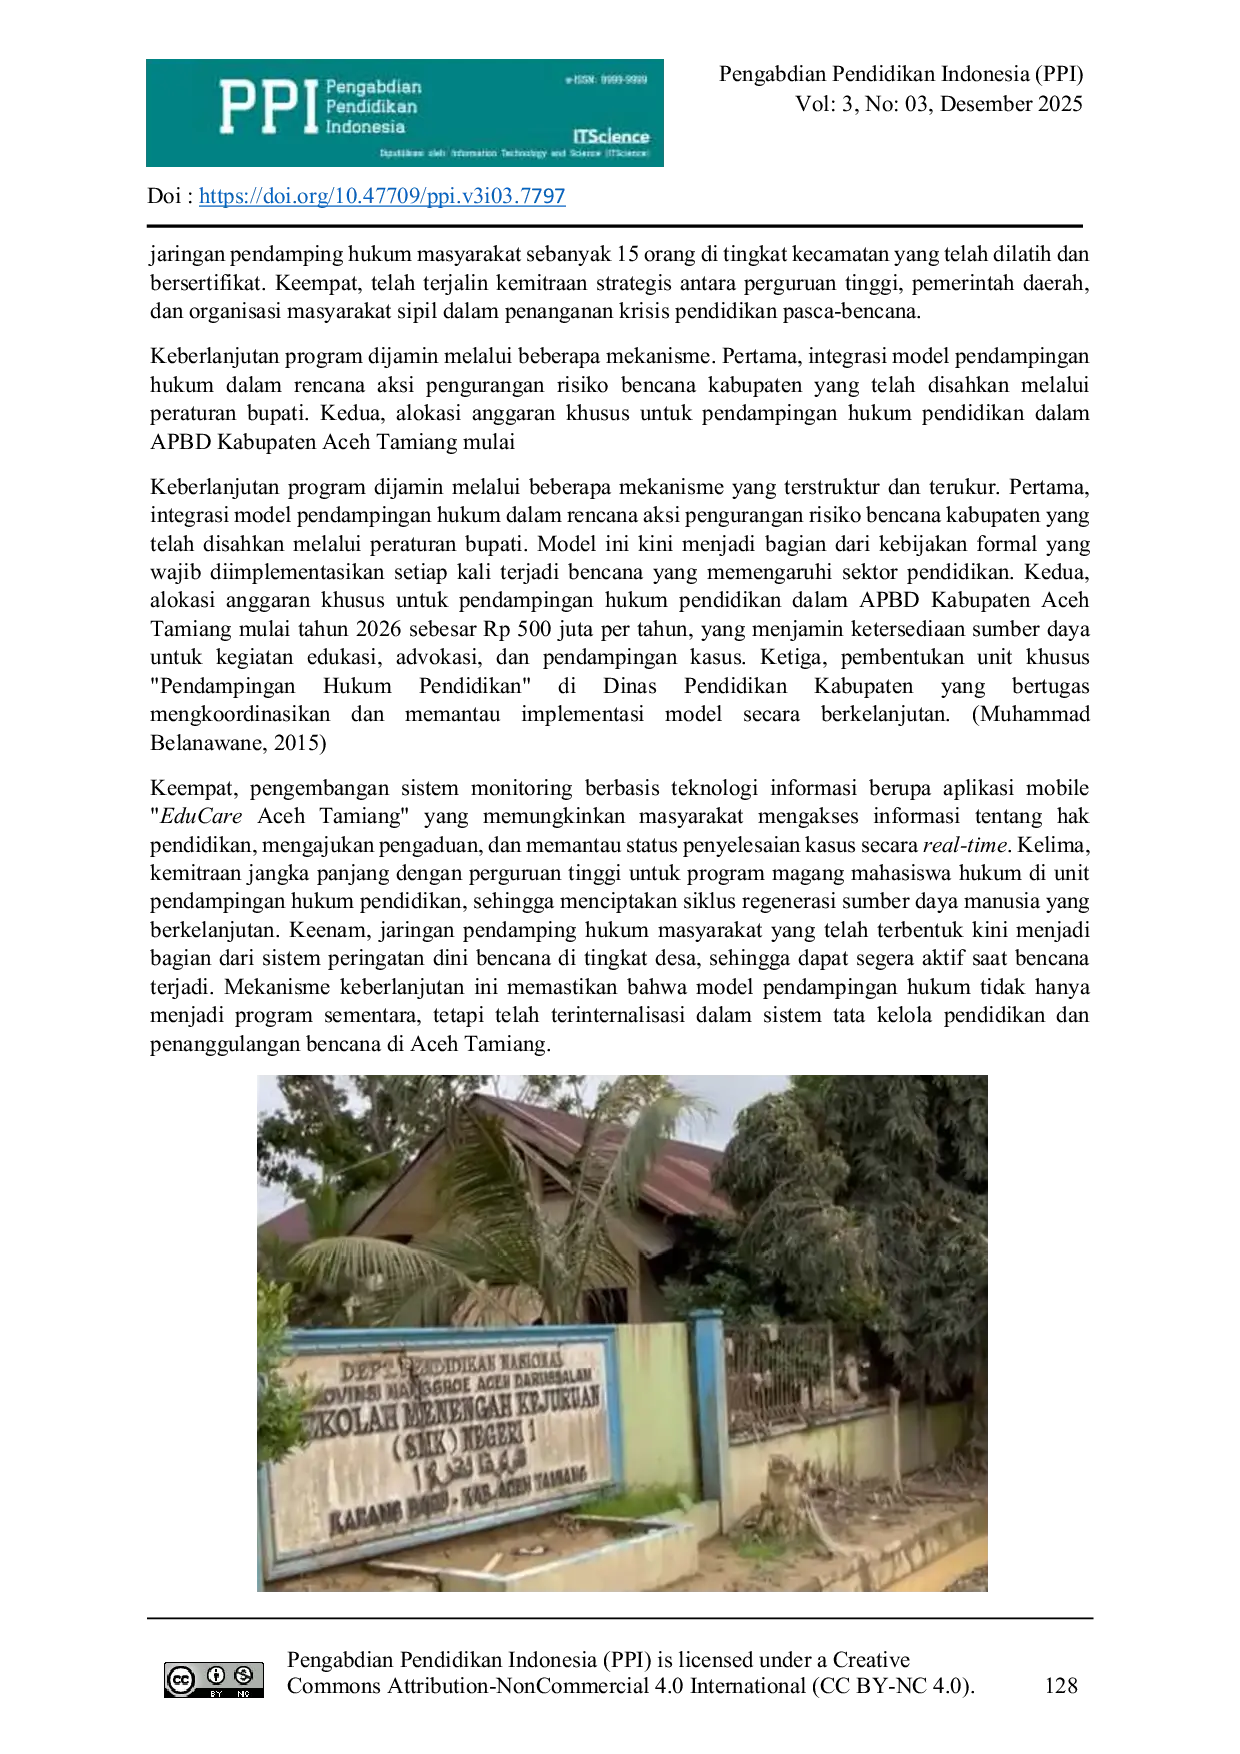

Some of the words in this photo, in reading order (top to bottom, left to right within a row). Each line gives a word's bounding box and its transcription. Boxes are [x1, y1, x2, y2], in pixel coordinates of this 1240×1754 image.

[720, 65, 826, 86] Pengabdian
[833, 65, 935, 81] Pendidikan
[942, 65, 1030, 81] Indonesia
[1036, 65, 1083, 86] (PPI)
[326, 79, 422, 97] Pengabdian
[219, 78, 319, 135] PPI
[326, 99, 418, 114] Pendidikan
[796, 95, 835, 111] Vol:
[843, 95, 859, 114] 3,
[866, 96, 898, 111] No:
[906, 95, 933, 114] 03,
[941, 95, 1033, 111] Desember
[1039, 95, 1082, 111] 2025
[326, 119, 406, 134] Indonesia
[573, 127, 650, 144] ITScience
[148, 187, 181, 203] Doi
[199, 187, 566, 208] https://doi.org/10.47709/ppi.v3i03.7797
[148, 245, 225, 266] jaringan
[230, 245, 343, 266] pendamping
[348, 245, 412, 261] hukum
[417, 245, 521, 266] masyarakat
[527, 245, 612, 266] sebanyak
[619, 245, 638, 261] 15
[645, 250, 695, 266] orang
[702, 245, 718, 261] di
[724, 245, 787, 266] tingkat
[792, 245, 889, 261] kecamatan
[894, 250, 939, 266] yang
[945, 245, 988, 261] telah
[994, 245, 1051, 261] dilatih
[1058, 245, 1089, 261] dan
[151, 347, 279, 368] Keberlanjutan
[285, 352, 363, 368] program
[369, 347, 438, 368] dijamin
[444, 347, 512, 363] melalui
[518, 347, 600, 368] beberapa
[606, 347, 715, 363] mekanisme.
[723, 348, 802, 366] Pertama,
[809, 347, 887, 368] integrasi
[892, 347, 949, 363] model
[955, 347, 1089, 368] pendampingan
[150, 434, 211, 449] APBD
[218, 433, 316, 454] Kabupaten
[322, 433, 370, 449] Aceh
[377, 433, 457, 454] Tamiang
[463, 433, 515, 449] mulai
[151, 620, 231, 641] Tamiang
[239, 620, 290, 636] mulai
[299, 620, 348, 636] tahun
[357, 620, 401, 636] 2026
[410, 620, 477, 636] sebesar
[484, 621, 510, 641] Rp
[518, 620, 551, 636] 500
[557, 620, 593, 641] juta
[601, 625, 630, 641] per
[638, 620, 693, 639] tahun,
[701, 625, 745, 641] yang
[752, 620, 843, 641] menjamin
[851, 620, 965, 636] ketersediaan
[973, 620, 1040, 636] sumber
[1048, 620, 1090, 641] daya
[151, 677, 295, 698] "Pendampingan
[324, 677, 392, 693] Hukum
[420, 677, 530, 693] Pendidikan"
[559, 677, 576, 693] di
[604, 677, 656, 693] Dinas
[685, 677, 787, 693] Pendidikan
[815, 677, 913, 698] Kabupaten
[941, 682, 985, 698] yang
[1012, 677, 1089, 698] bertugas
[151, 734, 267, 753] Belanawane,
[275, 734, 326, 754] 2015)
[151, 807, 242, 824] "EduCare
[257, 807, 305, 823] Aceh
[320, 807, 408, 828] Tamiang"
[424, 812, 468, 828] yang
[483, 807, 625, 828] memungkinkan
[639, 807, 743, 828] masyarakat
[758, 807, 858, 828] mengakses
[874, 807, 960, 823] informasi
[976, 809, 1042, 828] tentang
[1057, 807, 1090, 823] hak
[151, 978, 213, 999] terjadi.
[225, 978, 330, 994] Mekanisme
[340, 978, 464, 999] keberlanjutan
[475, 978, 498, 994] ini
[507, 978, 617, 994] memastikan
[627, 978, 687, 994] bahwa
[696, 978, 753, 994] model
[763, 978, 897, 999] pendampingan
[907, 978, 971, 994] hukum
[981, 978, 1026, 994] tidak
[1035, 978, 1090, 999] hanya
[150, 1035, 300, 1056] penanggulangan
[306, 1035, 381, 1051] bencana
[388, 1035, 404, 1051] di
[410, 1035, 458, 1051] Aceh
[465, 1035, 550, 1056] Tamiang.
[500, 1351, 563, 1371] NASIONAL
[402, 1393, 512, 1430] MENENGAH
[515, 1384, 600, 1417] KEJURUAN
[461, 1421, 523, 1450] NEGERI
[528, 1418, 536, 1442] 1
[288, 1651, 393, 1672] Pengabdian
[401, 1651, 502, 1667] Pendidikan
[509, 1651, 597, 1667] Indonesia
[604, 1651, 651, 1672] (PPI)
[658, 1651, 672, 1667] is
[679, 1651, 753, 1667] licensed
[760, 1651, 812, 1667] under
[818, 1656, 827, 1667] a
[834, 1651, 910, 1667] Creative
[210, 1690, 223, 1698] BY
[237, 1690, 250, 1698] NC
[288, 1677, 380, 1693] Commons
[387, 1677, 649, 1693] Attribution-NonCommercial
[655, 1677, 683, 1693] 4.0
[691, 1677, 806, 1693] International
[813, 1677, 849, 1698] (CC
[857, 1677, 926, 1693] BY-NC
[933, 1677, 974, 1697] 4.0).
[1047, 1677, 1077, 1693] 128
